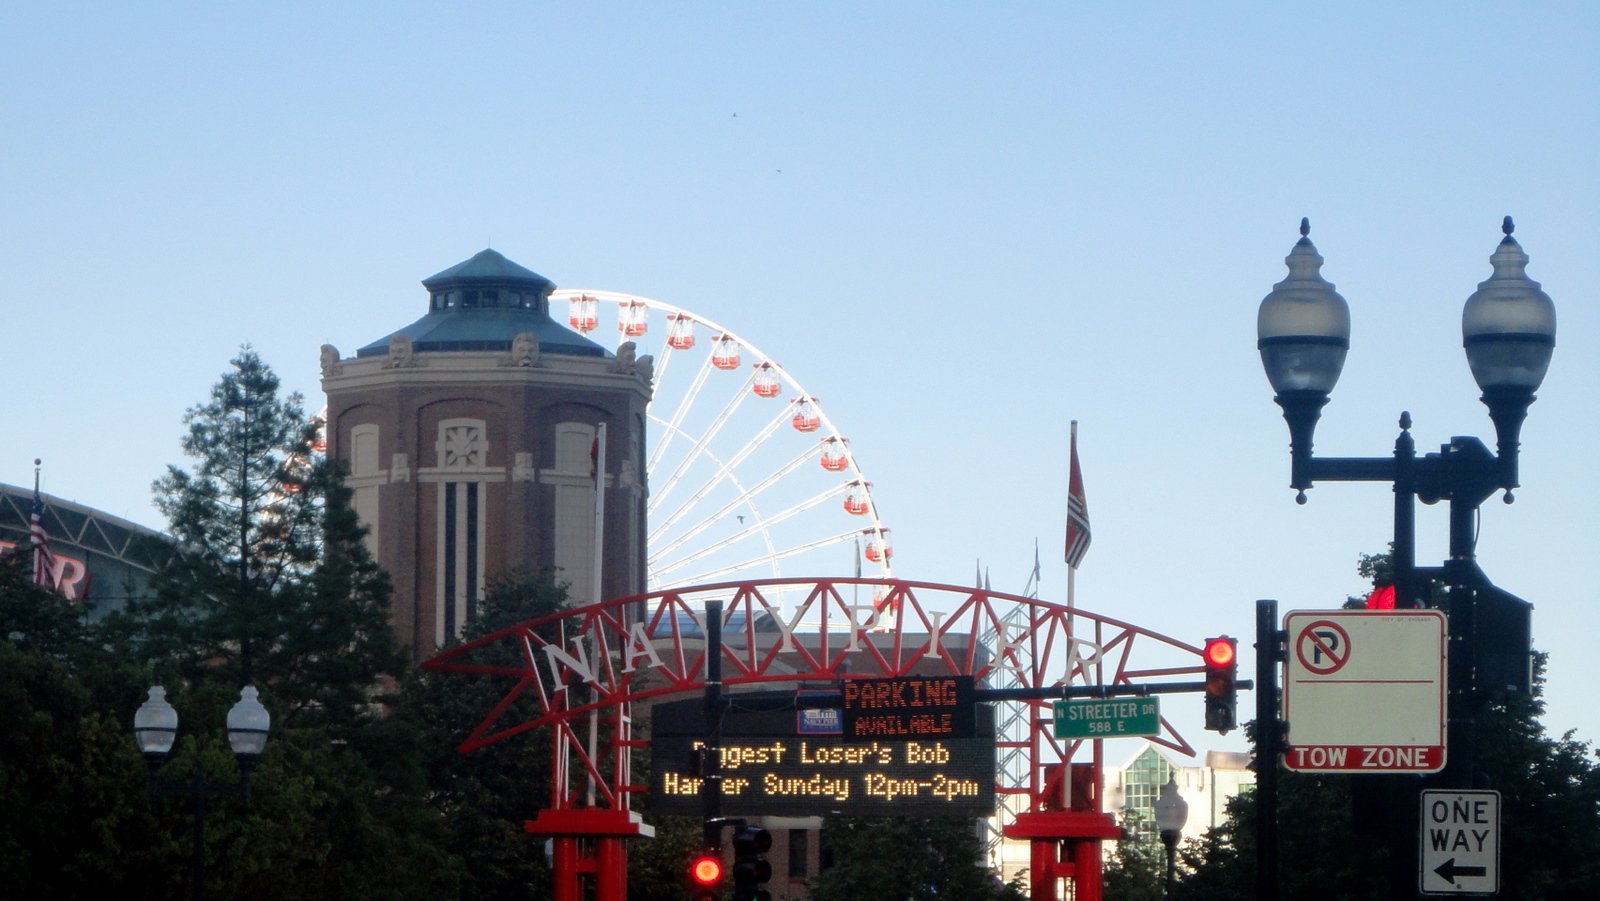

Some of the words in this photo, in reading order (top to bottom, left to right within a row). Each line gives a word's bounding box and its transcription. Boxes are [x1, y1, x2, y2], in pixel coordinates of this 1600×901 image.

[843, 604, 1103, 686] PIER
[844, 680, 957, 709] PARKING
[1057, 707, 1065, 719] N
[1069, 702, 1138, 720] STREETER
[1142, 704, 1155, 715] DR
[855, 714, 953, 736] AVAILABLE
[1088, 721, 1111, 733] 588
[1117, 721, 1125, 732] E
[692, 741, 786, 769] ggest
[801, 741, 893, 765] Loser's
[906, 741, 950, 765] Bob
[1295, 747, 1348, 767] TOW
[1362, 747, 1429, 767] ZONE
[664, 773, 750, 795] Harer
[763, 773, 850, 801] Sunday
[864, 773, 979, 801] 12pm-2pm
[1431, 799, 1489, 824] ONE
[1430, 828, 1491, 853] WAY
